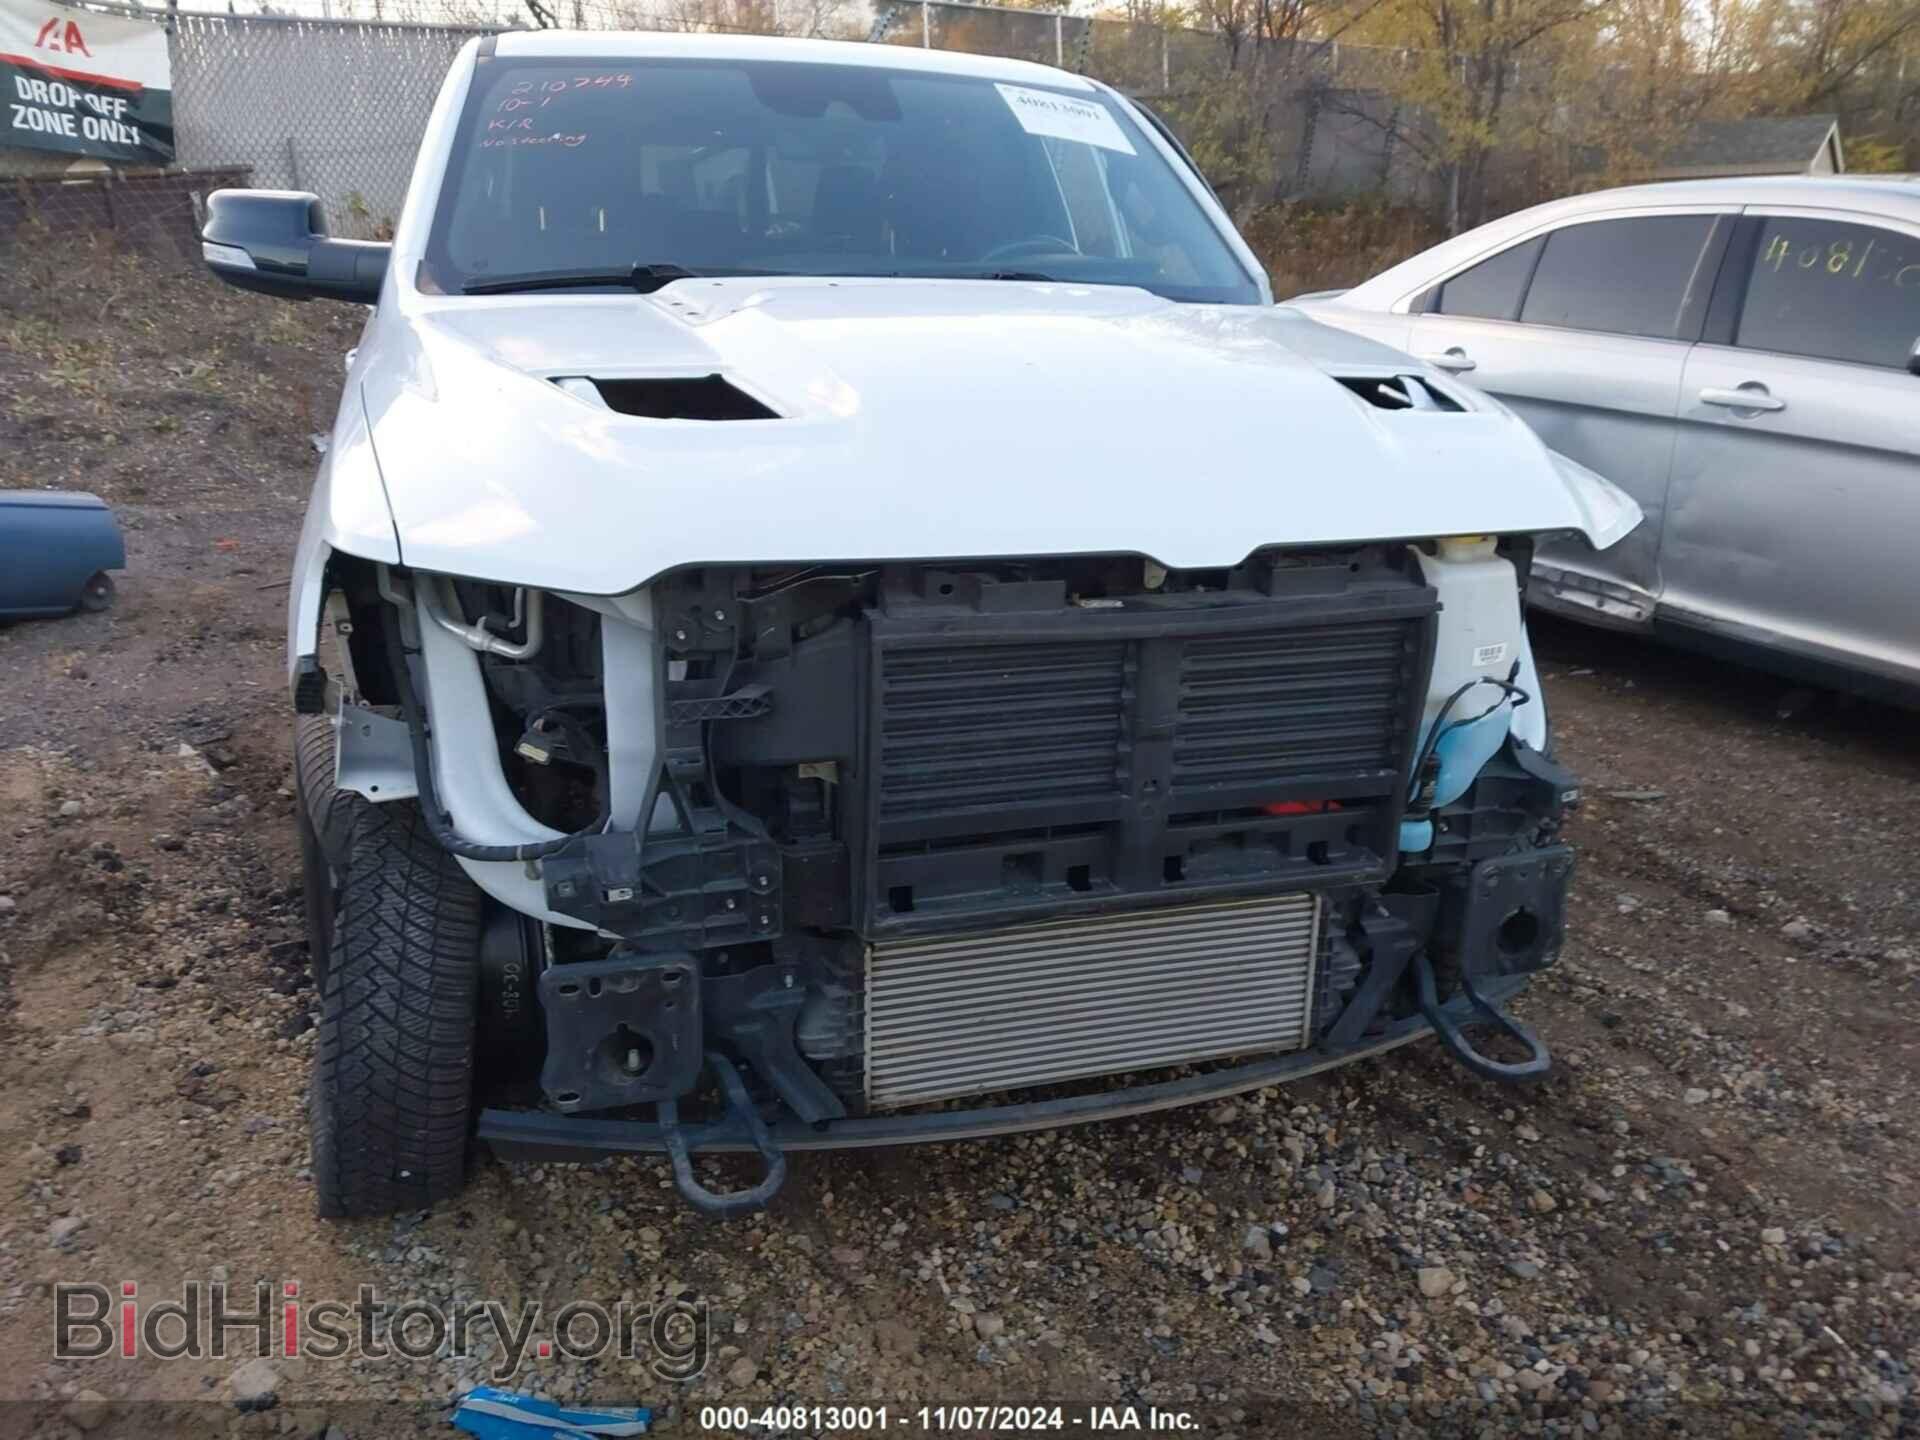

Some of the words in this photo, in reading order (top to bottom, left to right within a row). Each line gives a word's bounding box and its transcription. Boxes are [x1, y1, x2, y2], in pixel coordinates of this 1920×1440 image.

[14, 75, 81, 107] DROP
[84, 91, 128, 120] OFF
[10, 104, 76, 137] ZONE
[82, 119, 141, 145] ONLY
